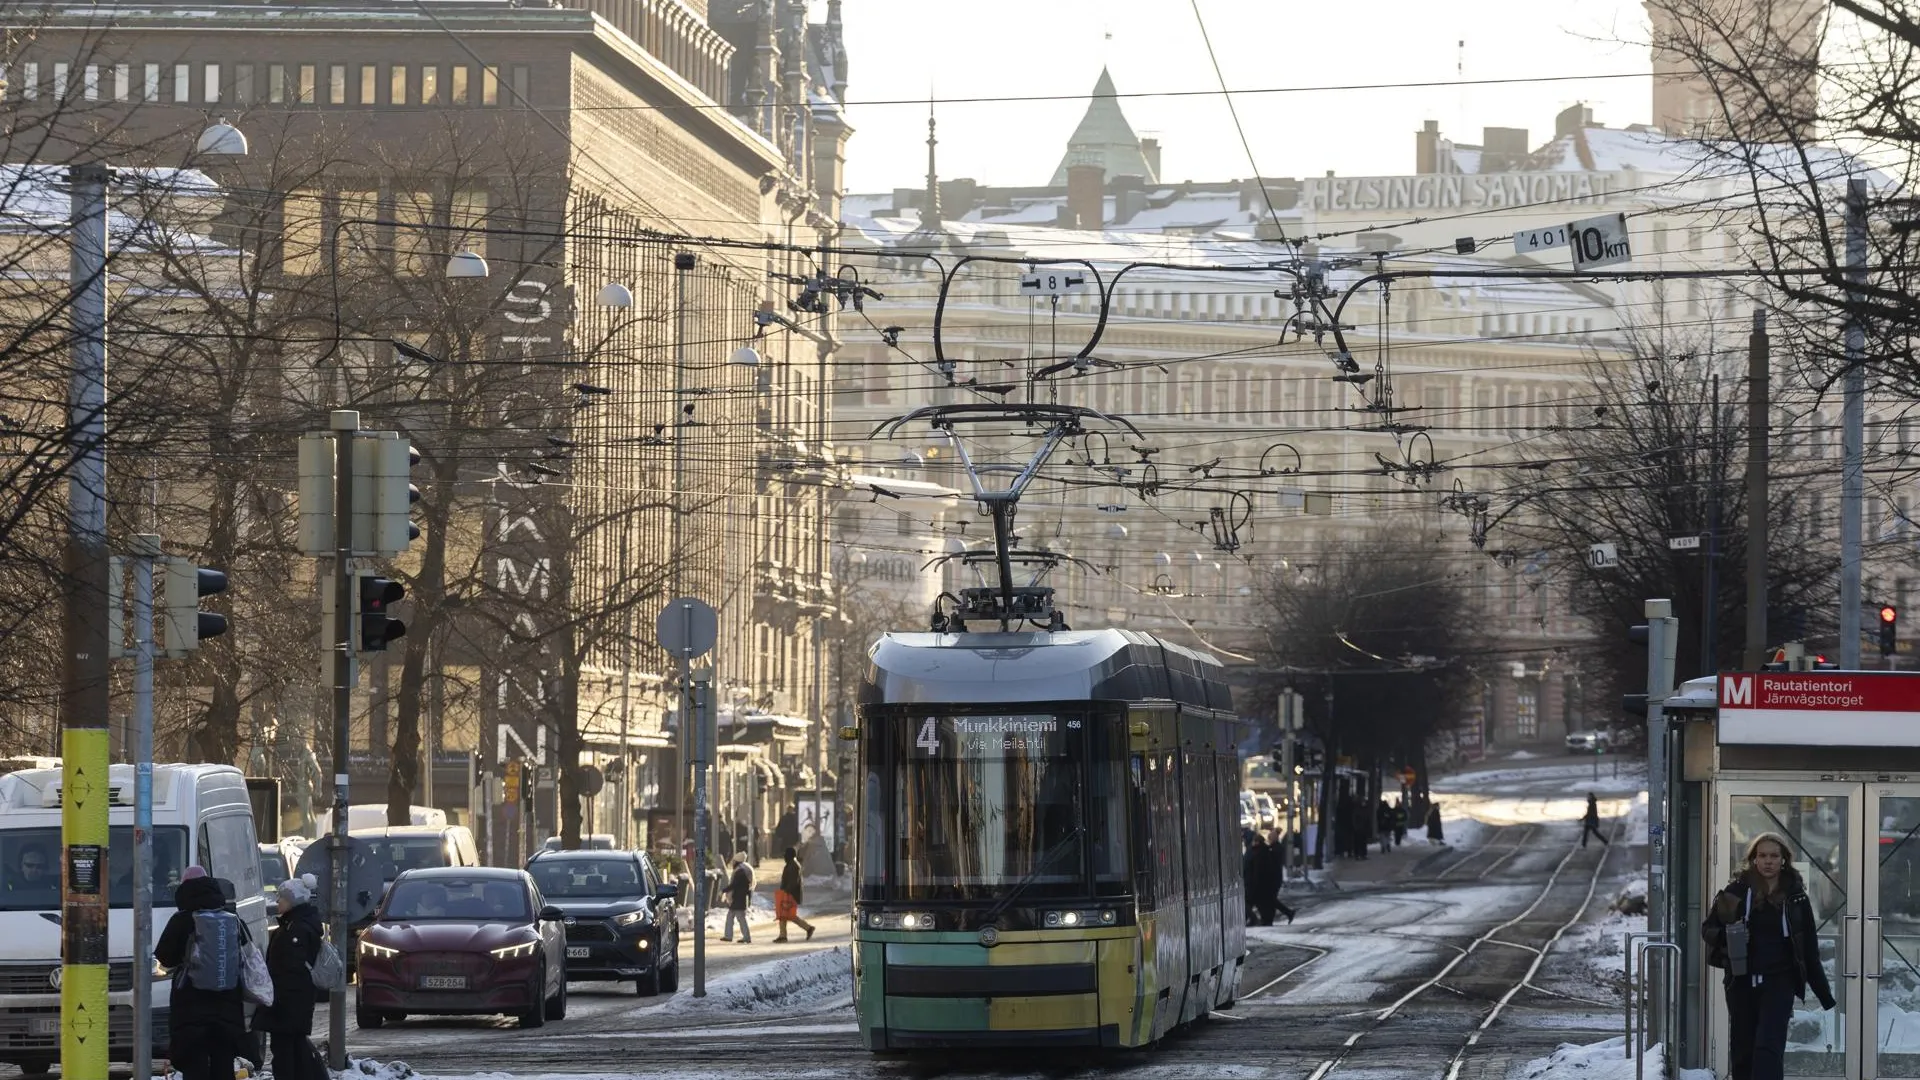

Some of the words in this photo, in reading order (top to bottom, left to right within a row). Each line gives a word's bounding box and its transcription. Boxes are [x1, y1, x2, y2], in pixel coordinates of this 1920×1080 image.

[1308, 174, 1464, 211] HELSINGIN
[1470, 172, 1615, 207] SANOMAT
[1529, 228, 1565, 248] 401
[1048, 275, 1057, 290] 8
[1723, 676, 1753, 705] M
[1763, 679, 1852, 693] Rautatientori
[1764, 692, 1864, 707] Järnvägstorget
[953, 717, 1057, 733] Munkkiniemi
[1066, 720, 1081, 729] 456
[916, 716, 940, 755] 4
[966, 739, 987, 750] via
[992, 737, 1046, 750] Meilahti
